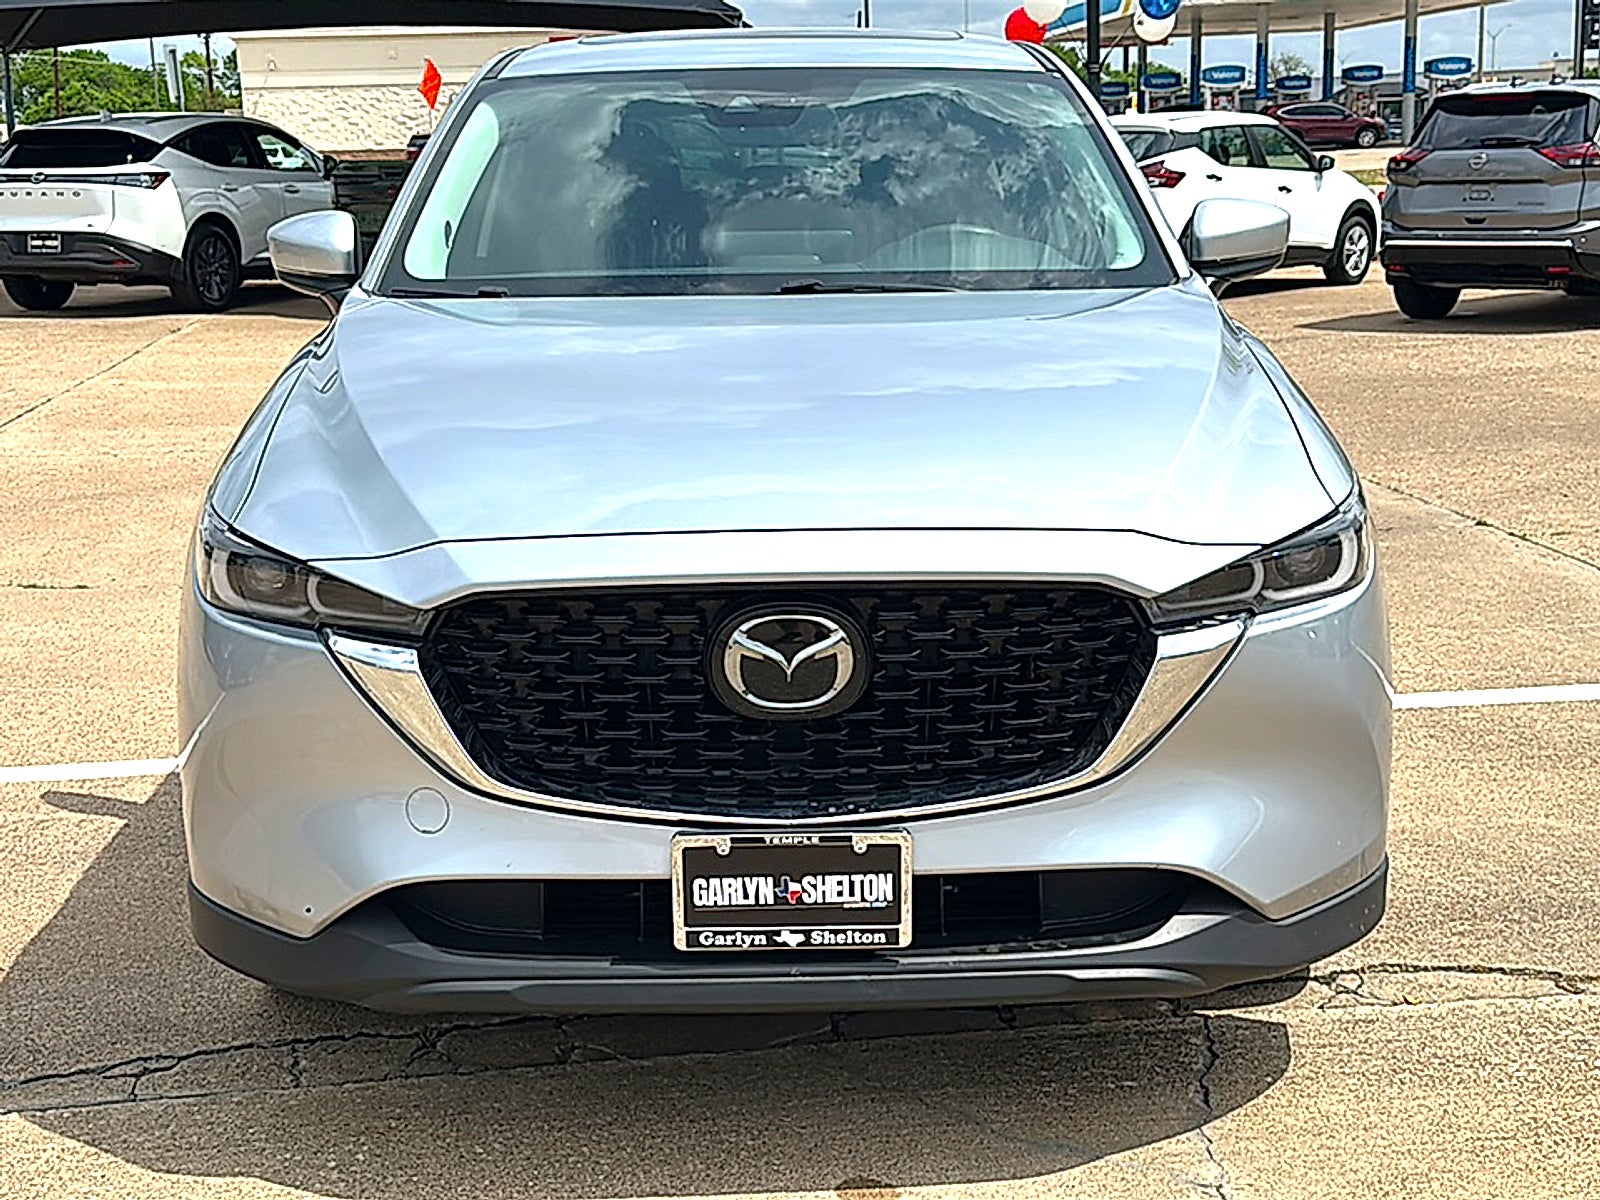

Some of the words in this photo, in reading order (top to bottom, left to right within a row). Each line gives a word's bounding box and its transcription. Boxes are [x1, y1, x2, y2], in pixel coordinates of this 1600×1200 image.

[764, 836, 820, 845] TEMPLE
[692, 876, 774, 906] GARLYN
[801, 873, 893, 903] SHELTON
[699, 931, 768, 948] Garlyn
[810, 930, 886, 945] Shelton
